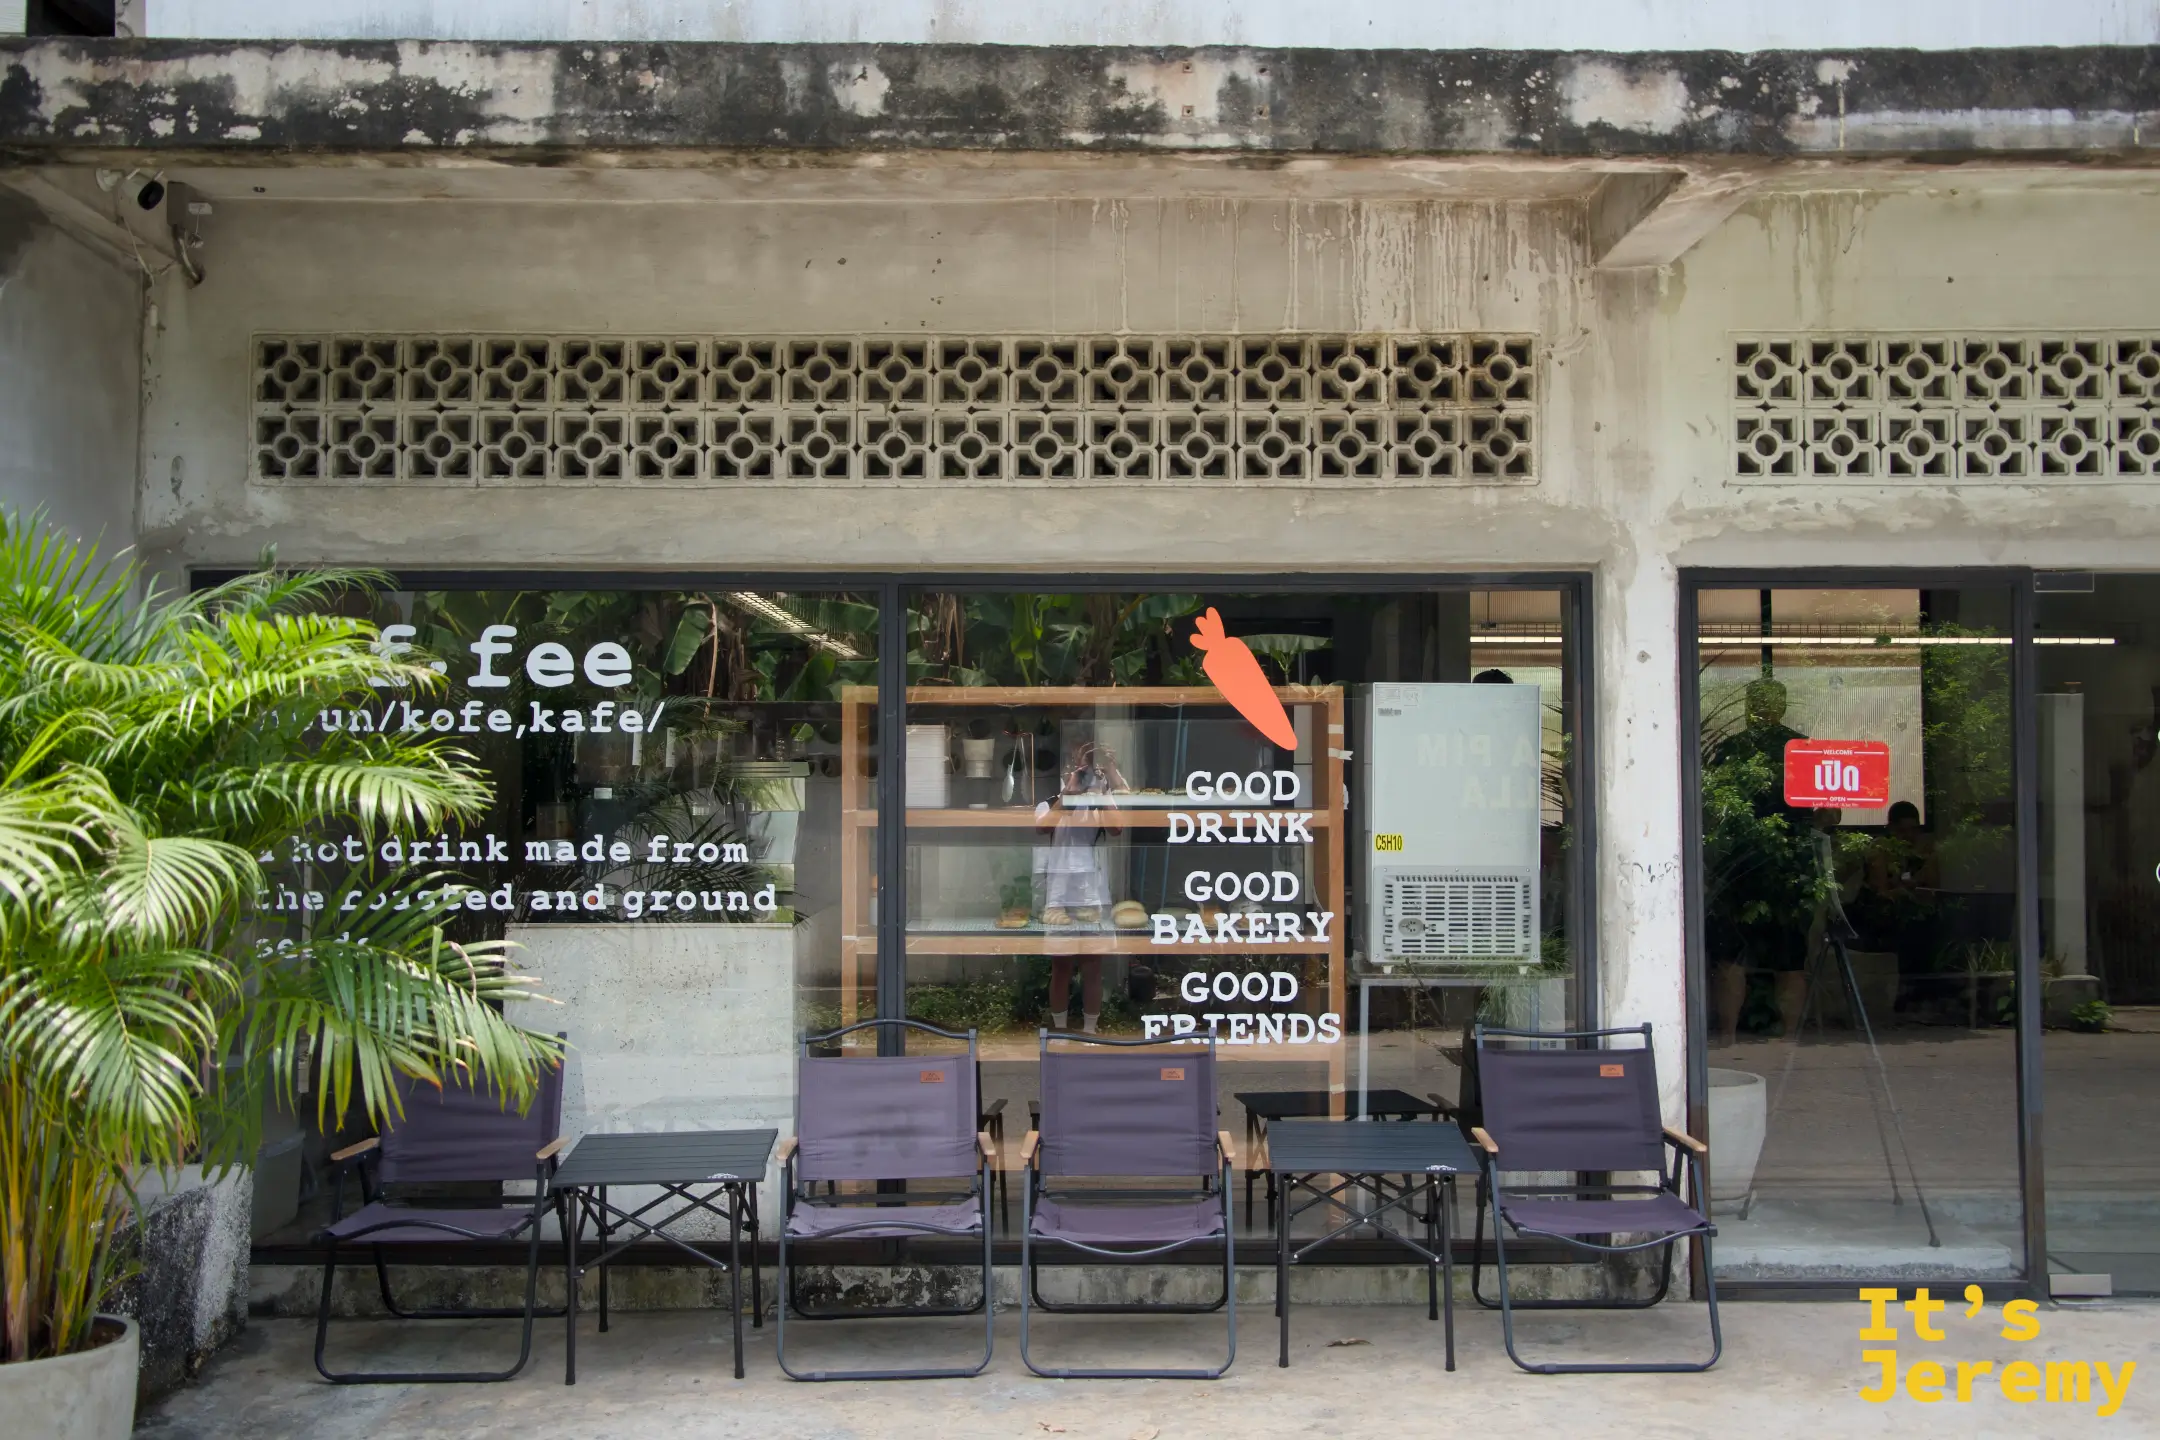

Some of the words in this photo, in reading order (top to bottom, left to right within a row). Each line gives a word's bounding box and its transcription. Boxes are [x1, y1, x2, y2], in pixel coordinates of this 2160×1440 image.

[259, 700, 665, 739] un/kofe,kafe/
[1822, 748, 1853, 756] WELCOME
[1186, 770, 1300, 802] GOOD
[1815, 760, 1859, 791] เปิด
[1167, 812, 1314, 844] DRINK
[1375, 834, 1403, 851] C5H10
[291, 834, 365, 862] hot
[381, 834, 509, 862] drink
[525, 834, 631, 863] made
[647, 834, 749, 863] from
[530, 883, 604, 911] and
[623, 883, 778, 918] ground
[1184, 870, 1300, 902] GOOD
[1150, 911, 1335, 945] BAKERY
[1181, 971, 1299, 1003] GOOD
[1141, 1013, 1342, 1045] FRIENDS
